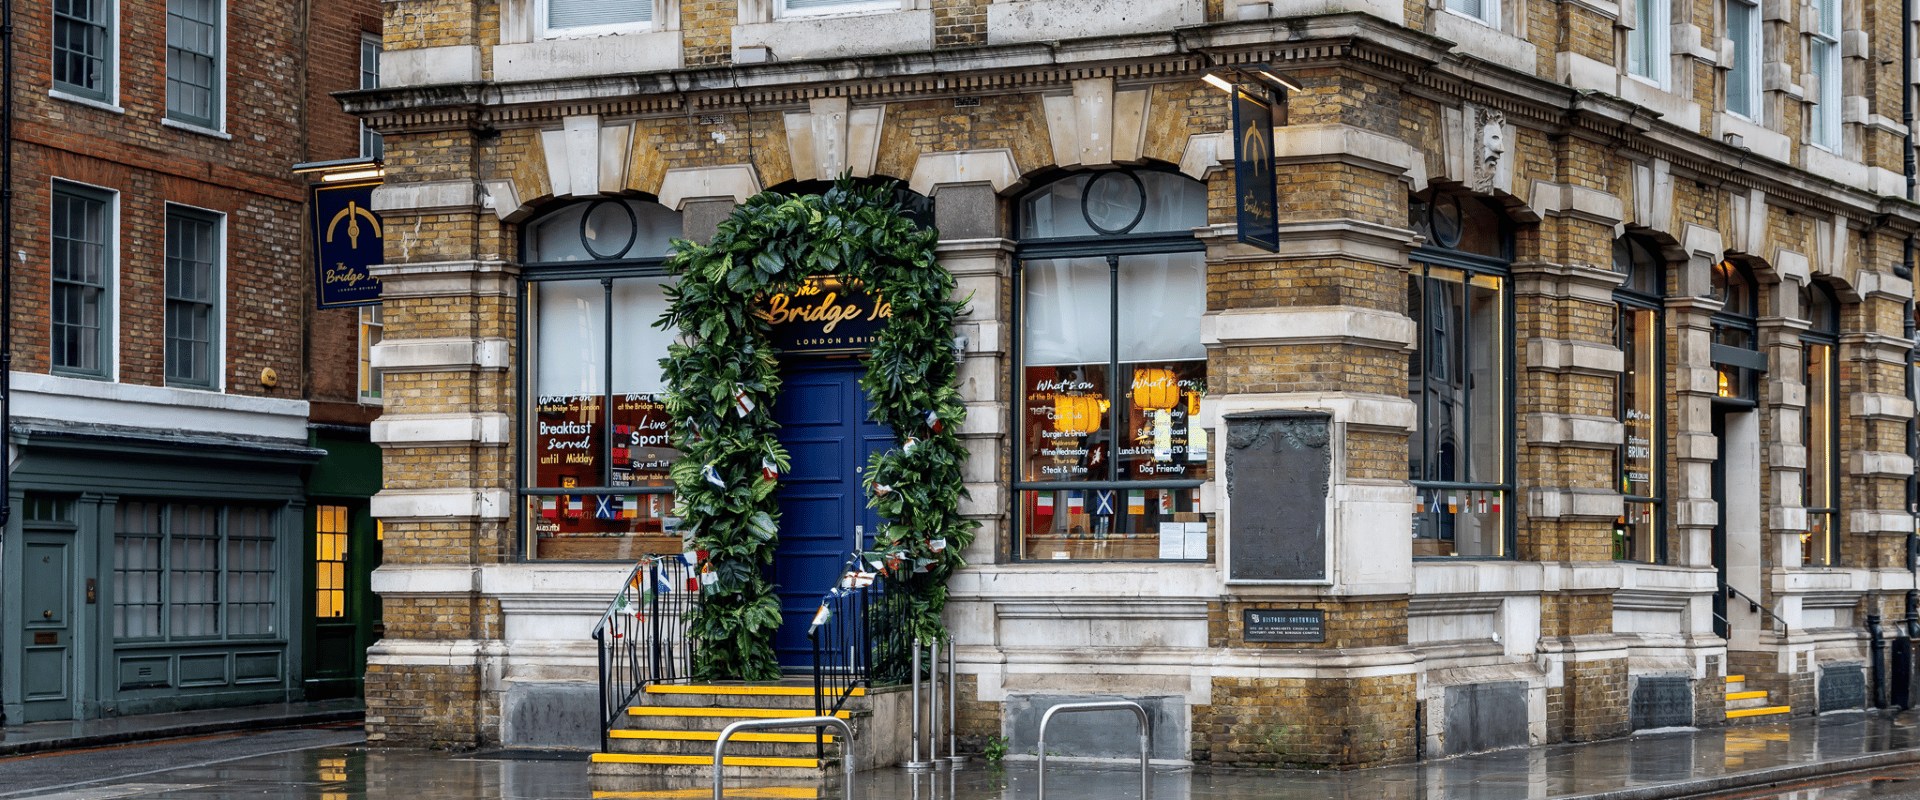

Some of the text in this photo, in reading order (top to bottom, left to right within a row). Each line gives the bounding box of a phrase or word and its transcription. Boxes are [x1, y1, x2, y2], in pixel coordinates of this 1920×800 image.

[336, 262, 347, 271] The
[326, 268, 365, 286] Bridge
[767, 288, 894, 334] Bridge Ta
[796, 337, 842, 345] LONDON
[1037, 379, 1076, 392] What's
[1131, 376, 1174, 389] What's
[553, 405, 568, 413] Bridge
[635, 403, 653, 411] Bridge
[654, 402, 664, 410] Tap
[540, 421, 592, 435] Breakfast
[639, 414, 667, 430] Live
[631, 430, 669, 447] Sport
[1042, 430, 1063, 439] Burger
[547, 435, 590, 450] Served
[1056, 447, 1089, 457] Wednesday
[1628, 446, 1649, 458] BRUNCH
[541, 453, 594, 466] until Midday
[633, 461, 644, 469] Sky
[1042, 466, 1062, 474] Steak
[1140, 464, 1185, 475] Dog Friendly
